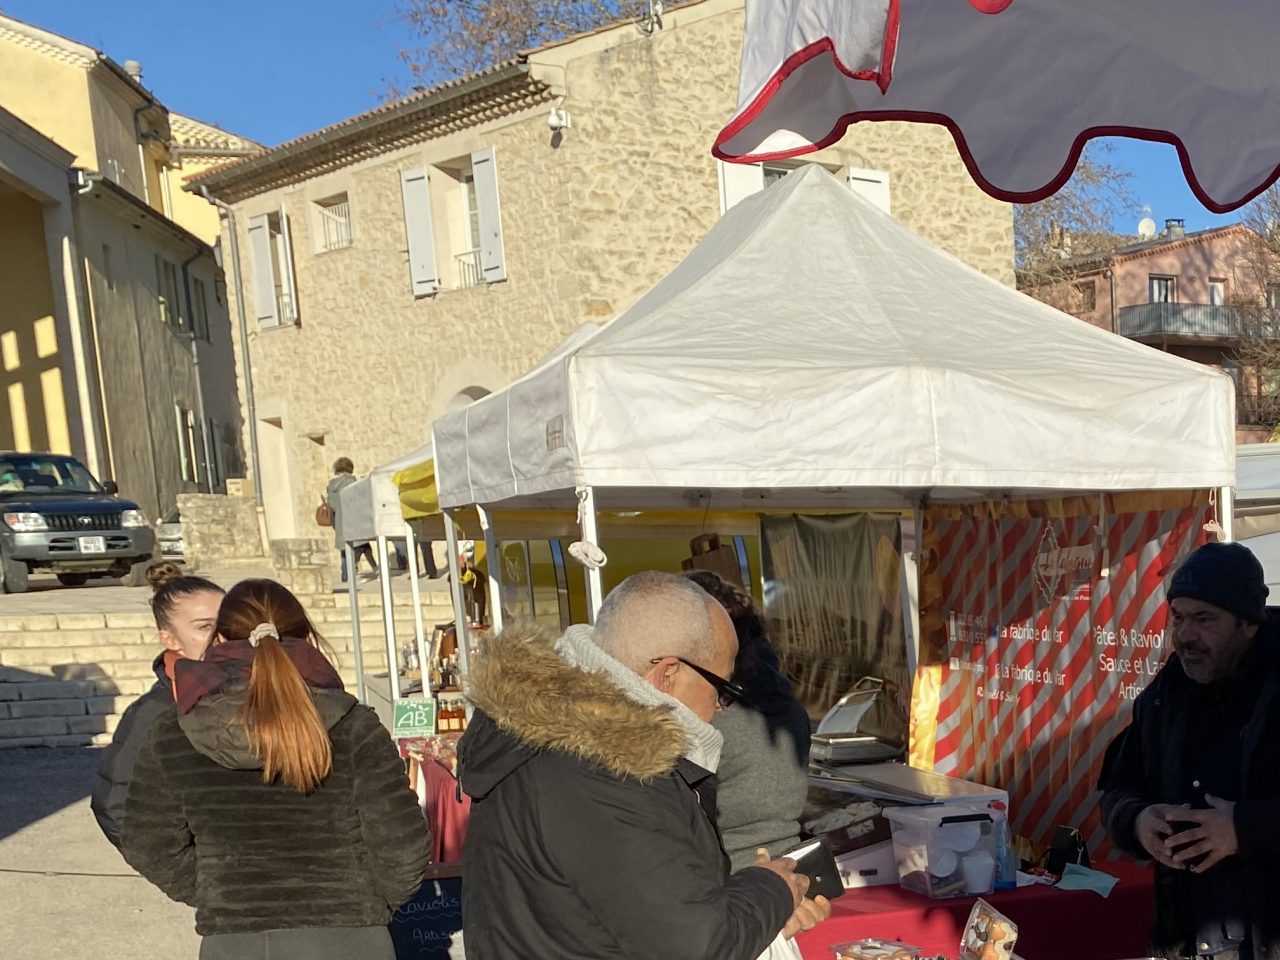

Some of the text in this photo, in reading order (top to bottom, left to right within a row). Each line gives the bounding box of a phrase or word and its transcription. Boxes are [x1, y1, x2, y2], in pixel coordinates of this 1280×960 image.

[1010, 624, 1040, 643] fabriqe
[1120, 628, 1128, 647] &
[1099, 653, 1132, 673] Sauce
[1134, 657, 1144, 674] et
[1011, 664, 1041, 685] fabriqe
[397, 711, 428, 727] AB
